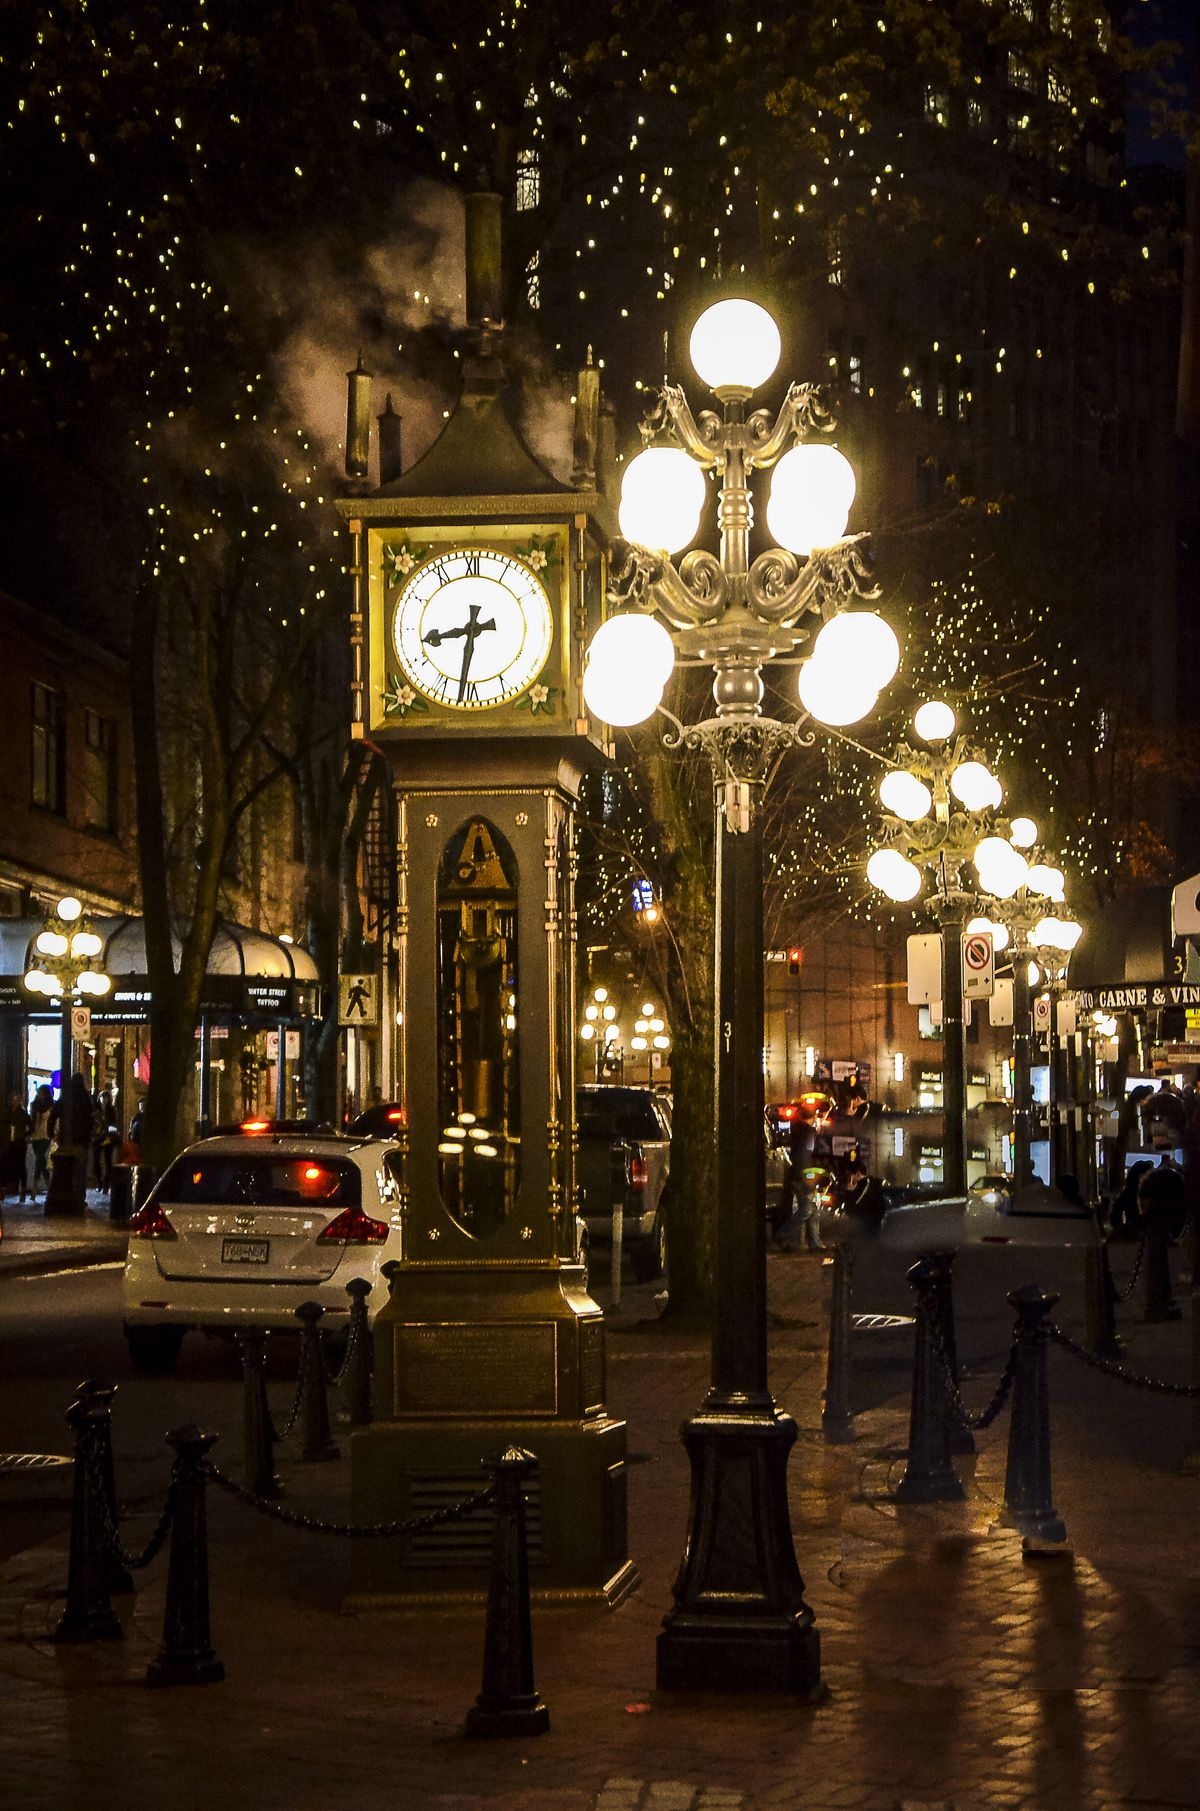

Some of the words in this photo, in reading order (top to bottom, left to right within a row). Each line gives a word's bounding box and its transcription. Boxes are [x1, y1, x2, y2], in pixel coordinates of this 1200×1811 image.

[466, 557, 480, 576] XII
[247, 987, 267, 996] WATER
[268, 988, 287, 997] STREET
[1099, 988, 1147, 1008] CARNE
[1152, 987, 1166, 1005] &
[1170, 986, 1200, 1004] VIN
[257, 998, 280, 1007] TATTOO
